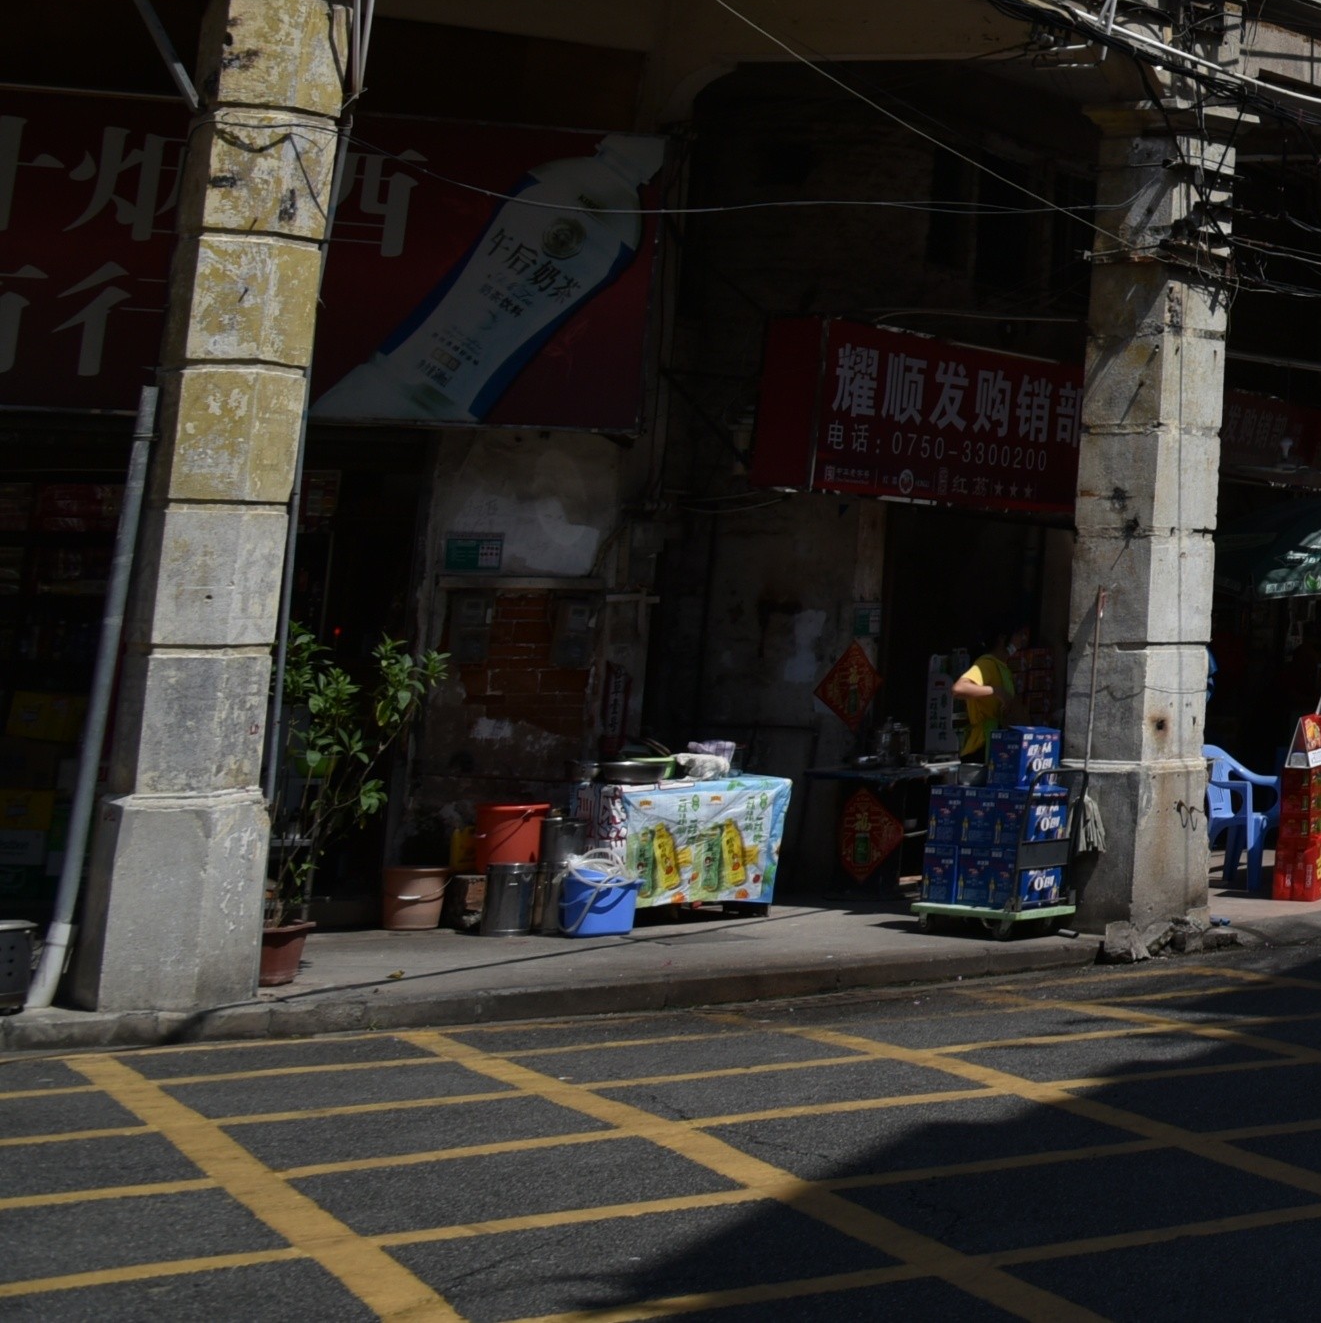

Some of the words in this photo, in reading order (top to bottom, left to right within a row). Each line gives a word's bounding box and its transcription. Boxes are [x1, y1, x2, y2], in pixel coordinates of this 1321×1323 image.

[486, 228, 582, 305] 午后奶茶
[831, 342, 1083, 448] 耀顺发购销部
